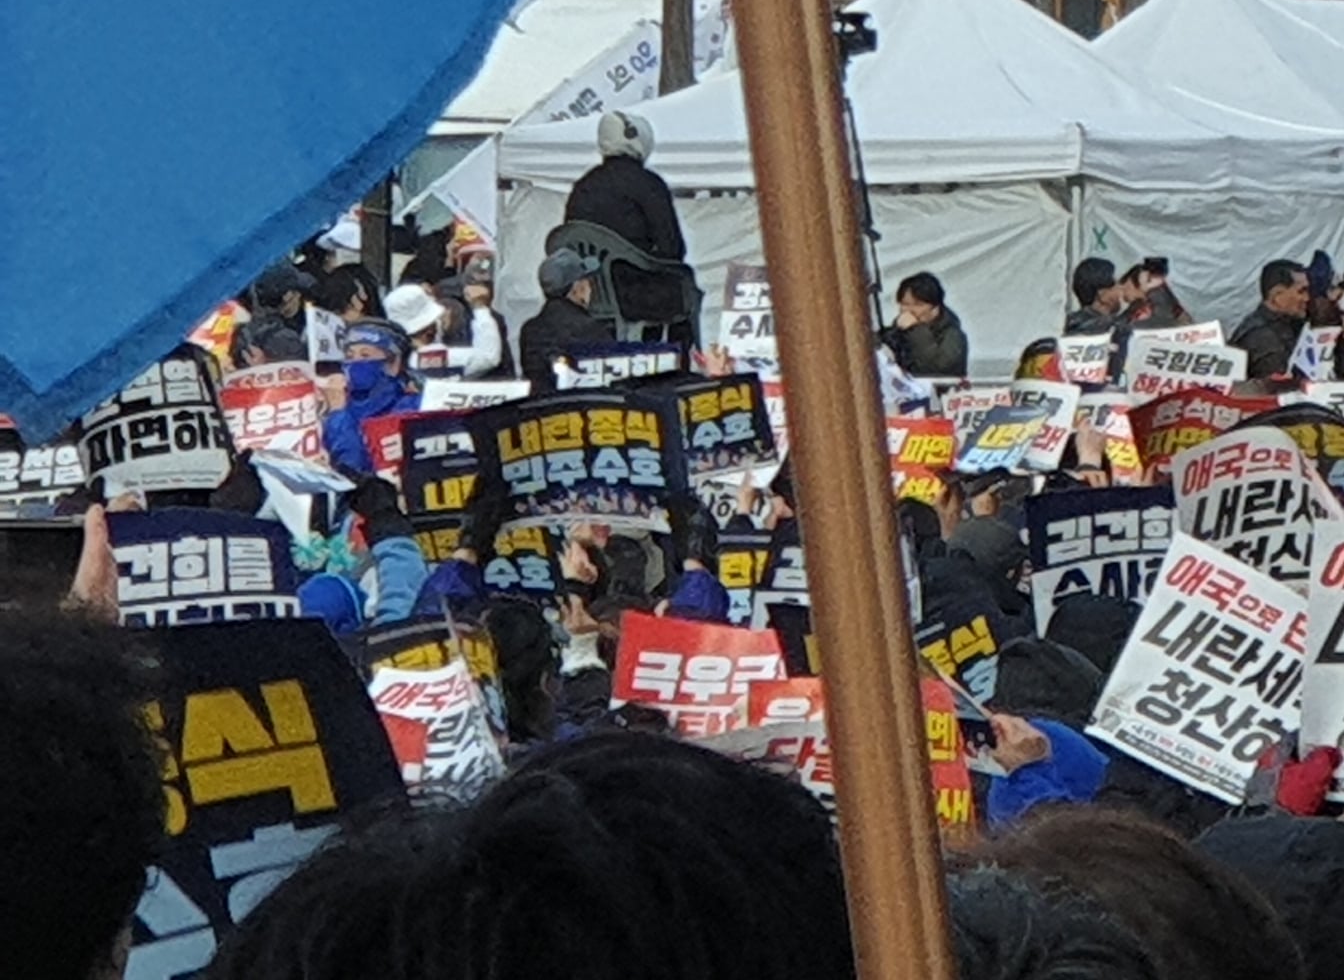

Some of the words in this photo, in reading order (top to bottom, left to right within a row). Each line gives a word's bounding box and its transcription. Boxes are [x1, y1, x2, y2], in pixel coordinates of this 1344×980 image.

[498, 411, 584, 463] 내란
[586, 407, 664, 451] 종식
[501, 449, 588, 496] 민주
[591, 445, 667, 488] 수호
[1046, 506, 1173, 560] 김건희
[116, 535, 276, 597] 건희를
[1140, 601, 1307, 712] 내란세
